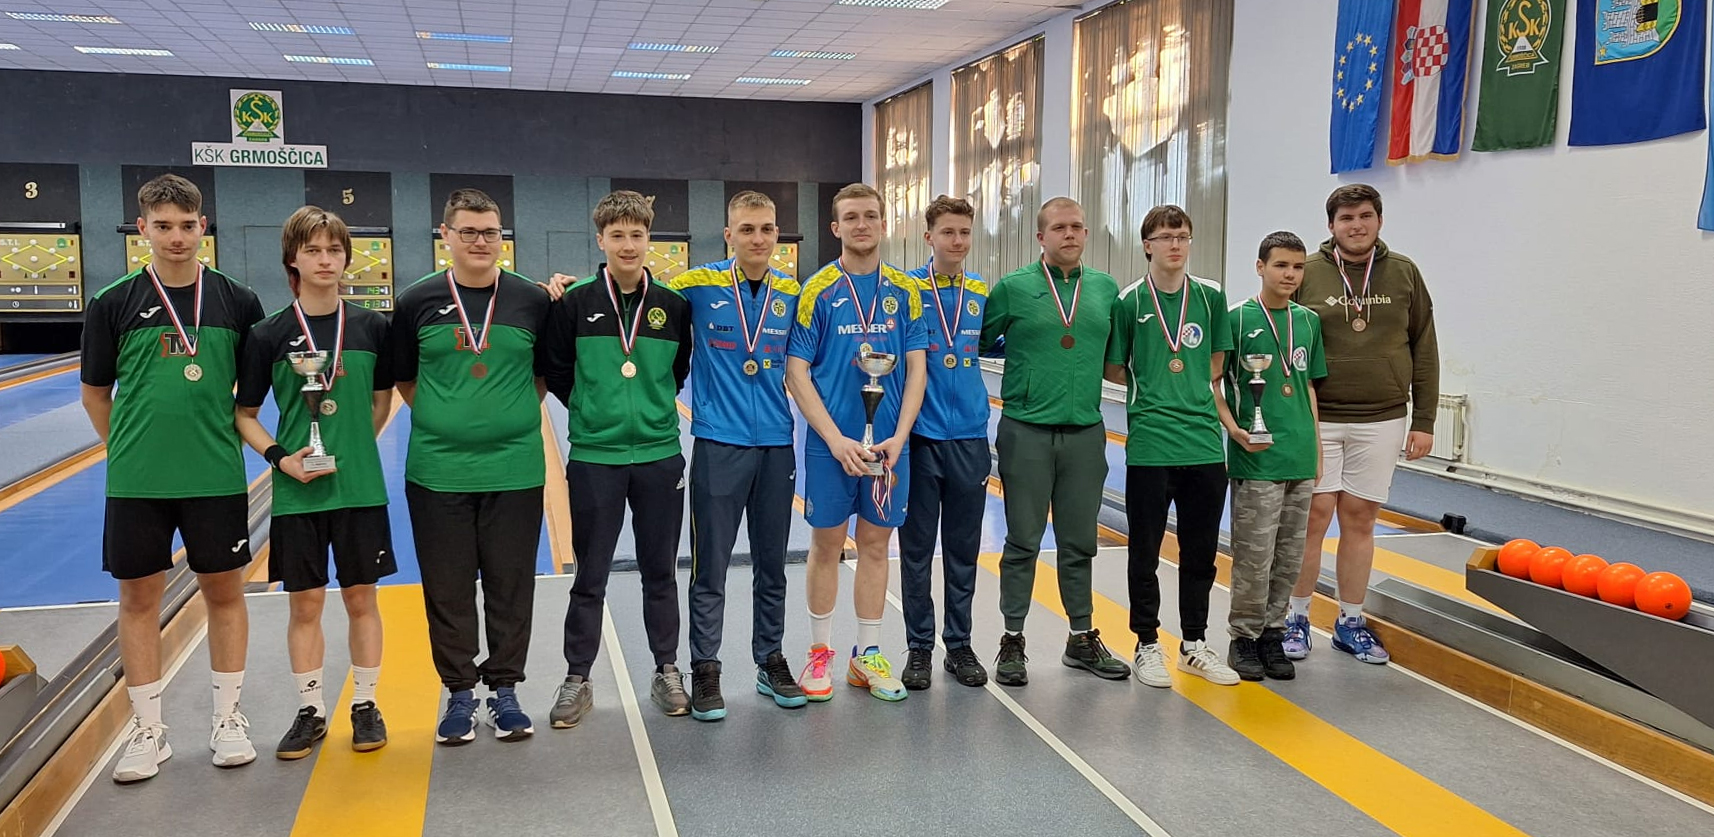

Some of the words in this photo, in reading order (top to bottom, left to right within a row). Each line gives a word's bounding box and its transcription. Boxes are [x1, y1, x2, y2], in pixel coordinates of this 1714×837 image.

[194, 145, 225, 163] KŠK
[230, 147, 324, 166] GRMOŠČICA
[25, 181, 38, 199] 3
[342, 188, 355, 205] 5
